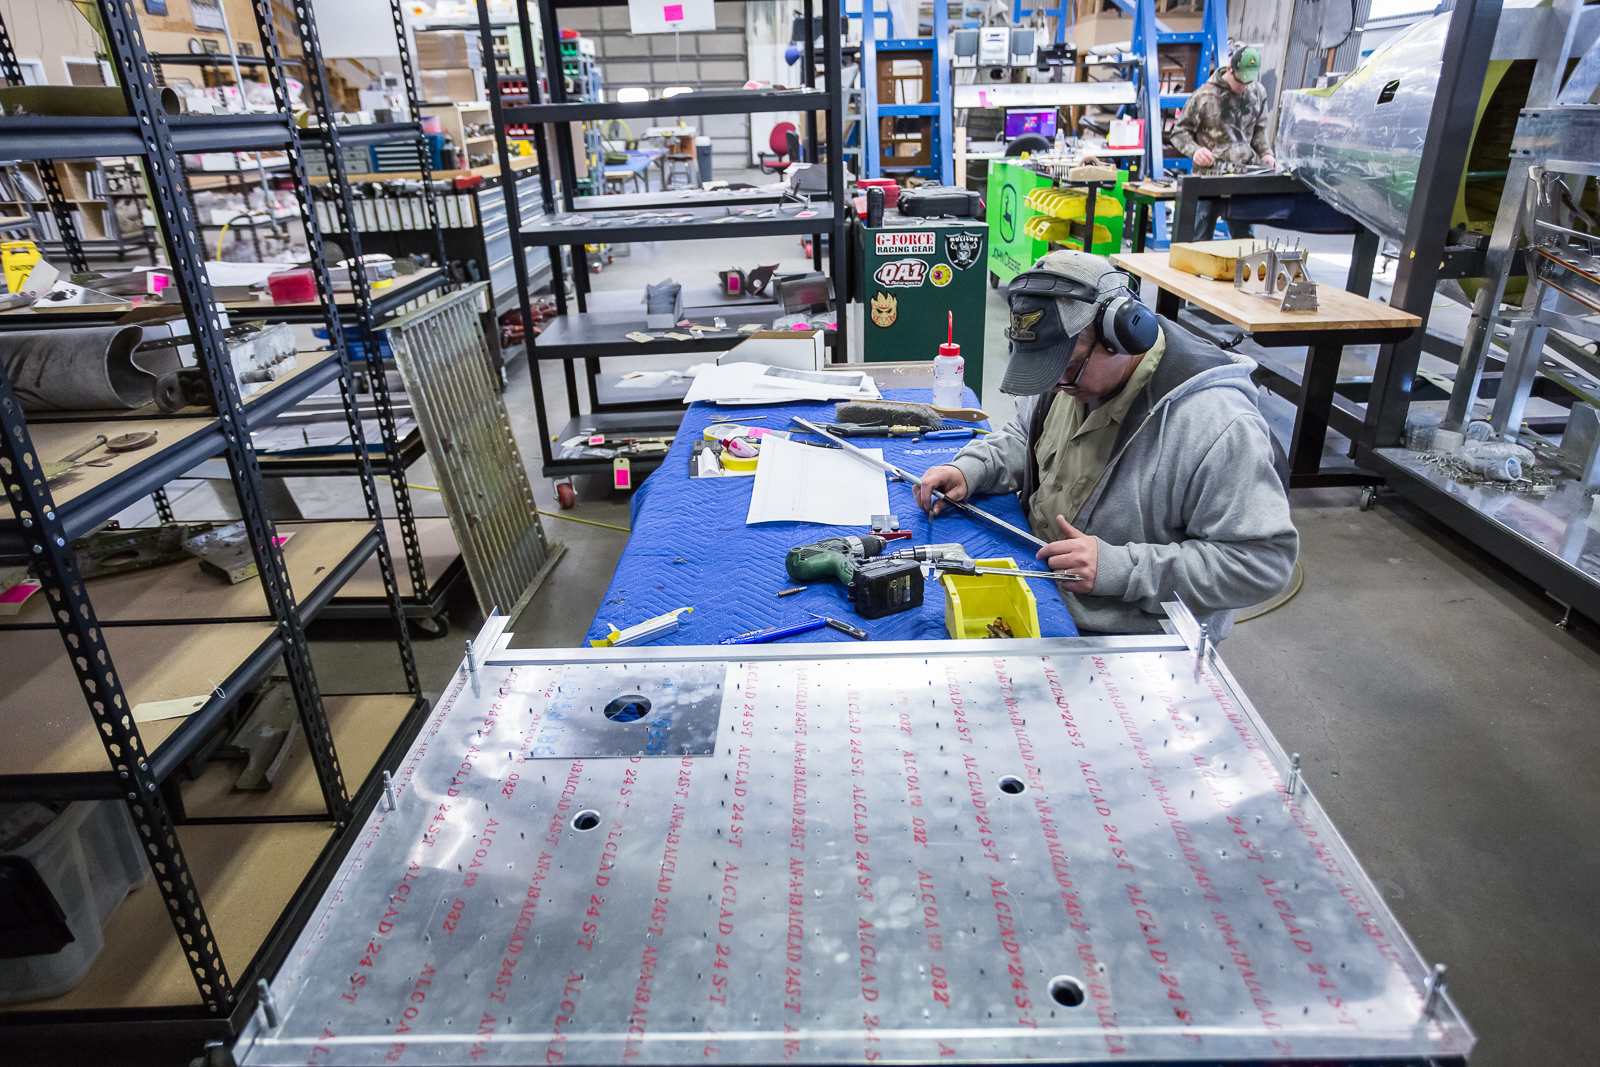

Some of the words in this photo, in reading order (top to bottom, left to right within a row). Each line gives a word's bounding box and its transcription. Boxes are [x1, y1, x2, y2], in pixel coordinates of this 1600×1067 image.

[876, 234, 934, 246] G-FORCE
[880, 264, 922, 286] QA1
[447, 745, 480, 797] ALCLAD
[734, 745, 751, 797] ALCLAD
[794, 741, 806, 774] AN-A-13
[1118, 709, 1142, 742] ALCLAD
[1167, 817, 1201, 862] ALCLAD
[557, 773, 579, 811] ALCLAD
[792, 776, 806, 815] ALCLAD
[852, 785, 869, 844] ALCLAD
[1013, 727, 1035, 761] ALCLAD
[1033, 797, 1058, 839] AN-A-13
[1046, 840, 1073, 888] ALCLAD
[1044, 667, 1069, 709] ALCLAD
[1078, 760, 1111, 817] ALCLAD
[1125, 884, 1168, 963] ALCLAD
[470, 818, 500, 868] ALCOA
[666, 804, 685, 844] AN-A-13
[903, 750, 920, 791] ALCOA
[918, 870, 939, 929] ALCOA
[527, 852, 553, 899] AN-A-13
[596, 822, 622, 886] ALCLAD
[657, 846, 678, 892] ALCLAD
[789, 858, 803, 906] AN-A-13
[963, 754, 986, 809] ALCLAD
[989, 876, 1020, 954] ALCLAD
[378, 862, 420, 933] ALCLAD
[718, 861, 739, 935] ALCLAD
[1257, 875, 1313, 954] ALCLAD
[508, 900, 537, 953] ALCLAD
[786, 907, 803, 963] ALCLAD
[635, 944, 658, 1003] AN-A-13
[858, 917, 879, 1002] ALCLAD
[396, 963, 436, 1033] ALCOA
